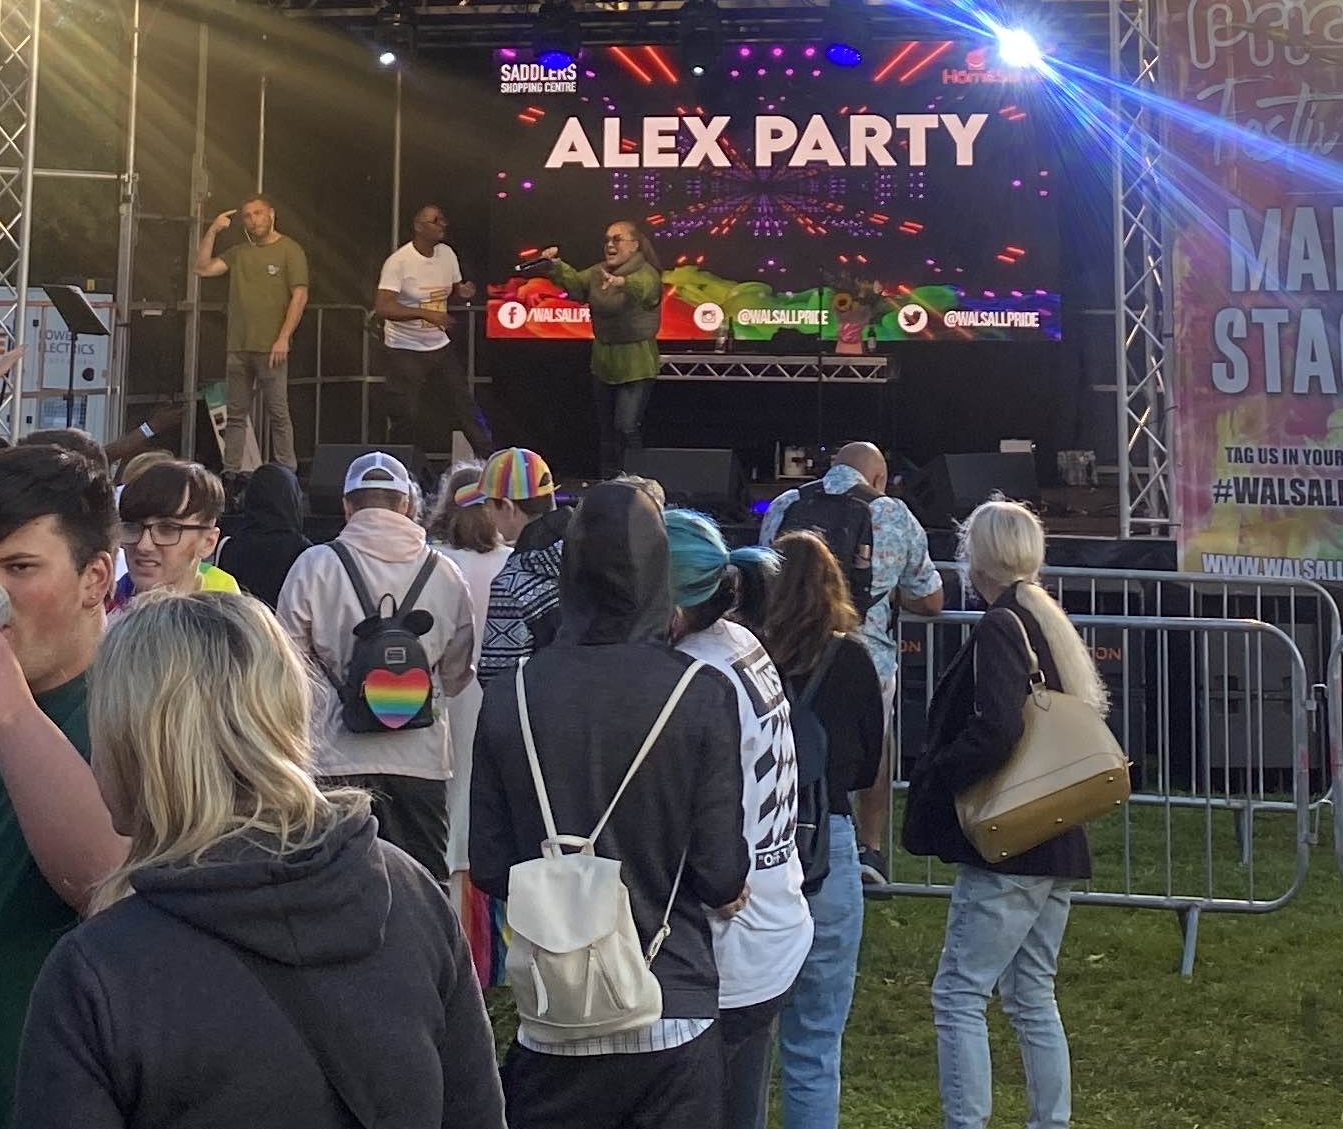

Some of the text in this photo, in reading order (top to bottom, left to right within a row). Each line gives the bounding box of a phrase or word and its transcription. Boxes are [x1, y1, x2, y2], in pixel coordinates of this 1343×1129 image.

[501, 63, 577, 82] SADDLERS
[501, 81, 577, 93] SHOPPING CENTRE
[545, 113, 989, 168] ALEX PARTY
[738, 309, 828, 324] @WALSALLPRIDE
[944, 310, 1040, 327] @WALSALLPRIDE
[1225, 447, 1253, 464] TAG
[1257, 447, 1279, 465] US
[1282, 448, 1298, 465] IN
